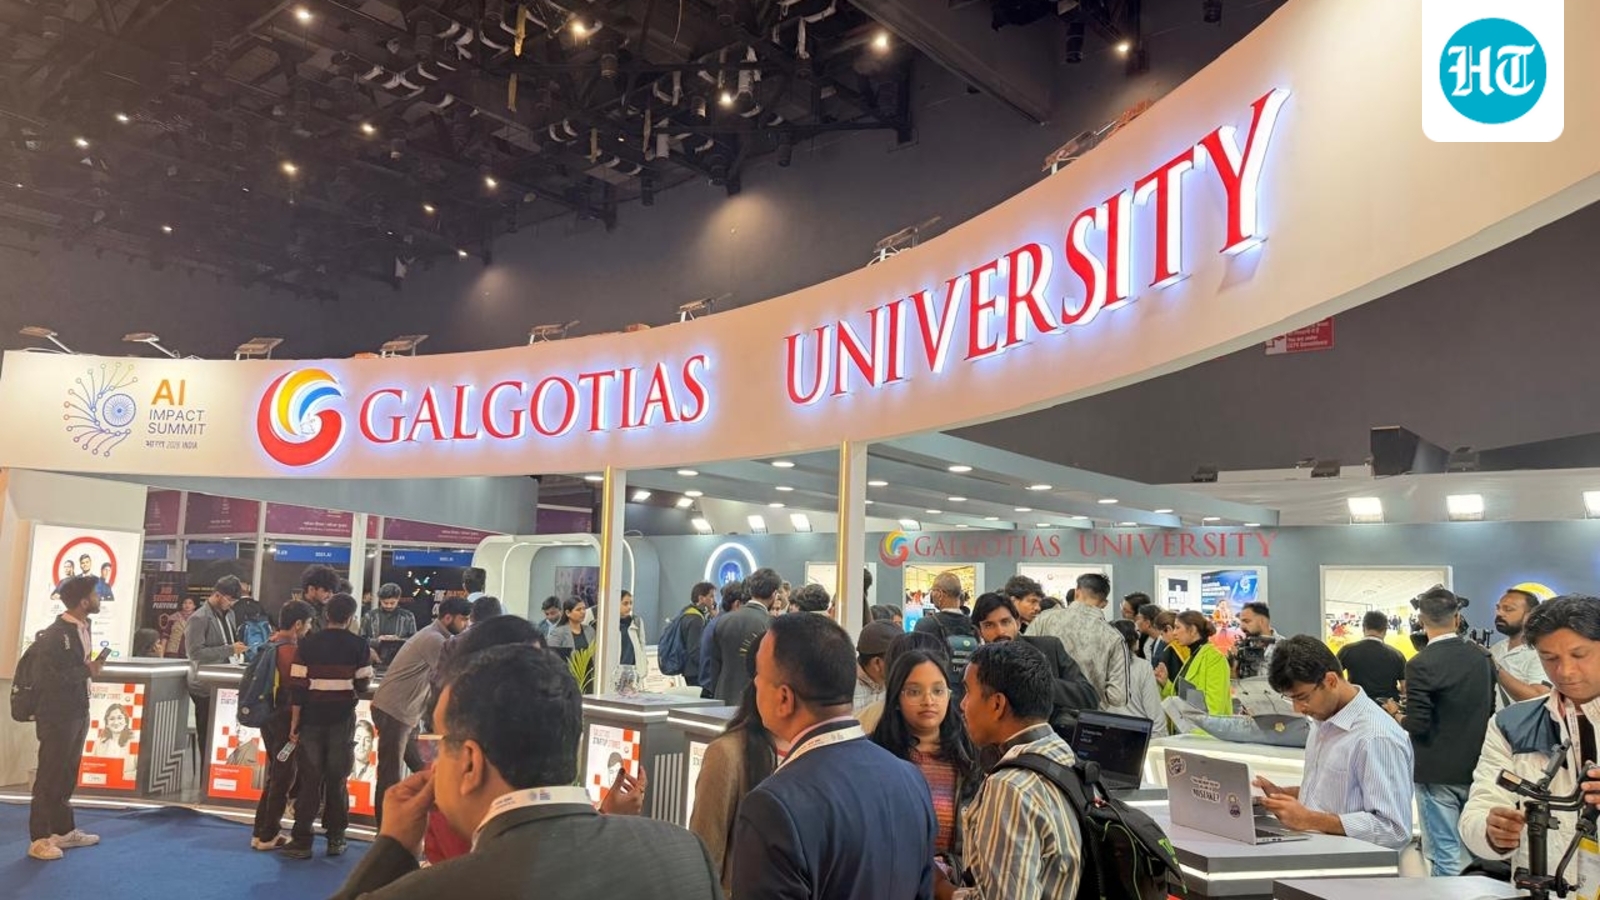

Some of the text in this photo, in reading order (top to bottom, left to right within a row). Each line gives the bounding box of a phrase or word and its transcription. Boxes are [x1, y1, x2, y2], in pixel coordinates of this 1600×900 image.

[358, 88, 1292, 444] GALGOTIAS UNIVERSITY
[151, 378, 186, 406] AI
[147, 421, 207, 435] SUMMIT
[149, 408, 206, 422] IMPACT
[914, 531, 1278, 558] GALGOTIAS UNIVERSITY
